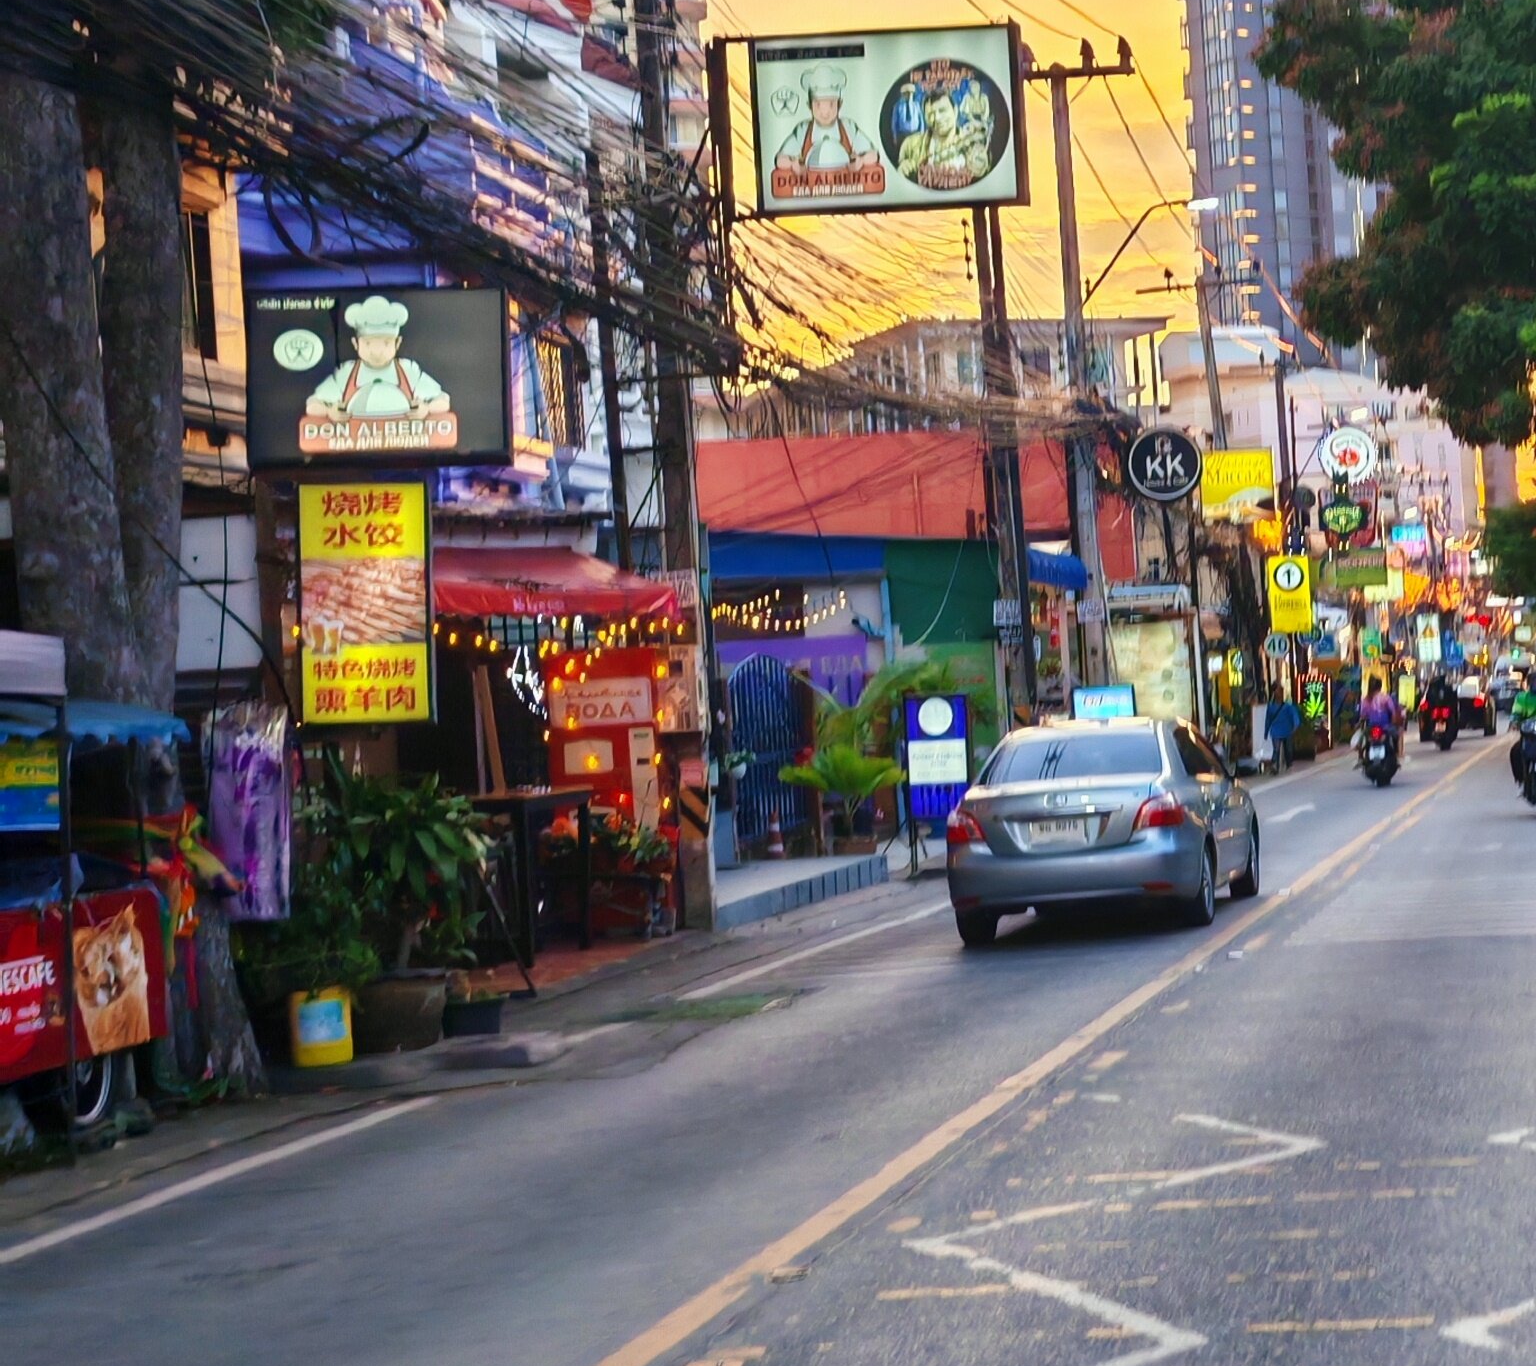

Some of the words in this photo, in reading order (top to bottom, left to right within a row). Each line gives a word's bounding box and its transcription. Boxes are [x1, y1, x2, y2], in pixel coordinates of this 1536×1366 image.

[777, 175, 809, 188] DON
[815, 172, 881, 185] ALBERTO
[304, 422, 350, 439] DON
[357, 419, 452, 437] ALBERTO
[1145, 452, 1185, 481] KK
[322, 490, 403, 517] 烧烤
[323, 521, 404, 547] 水饺
